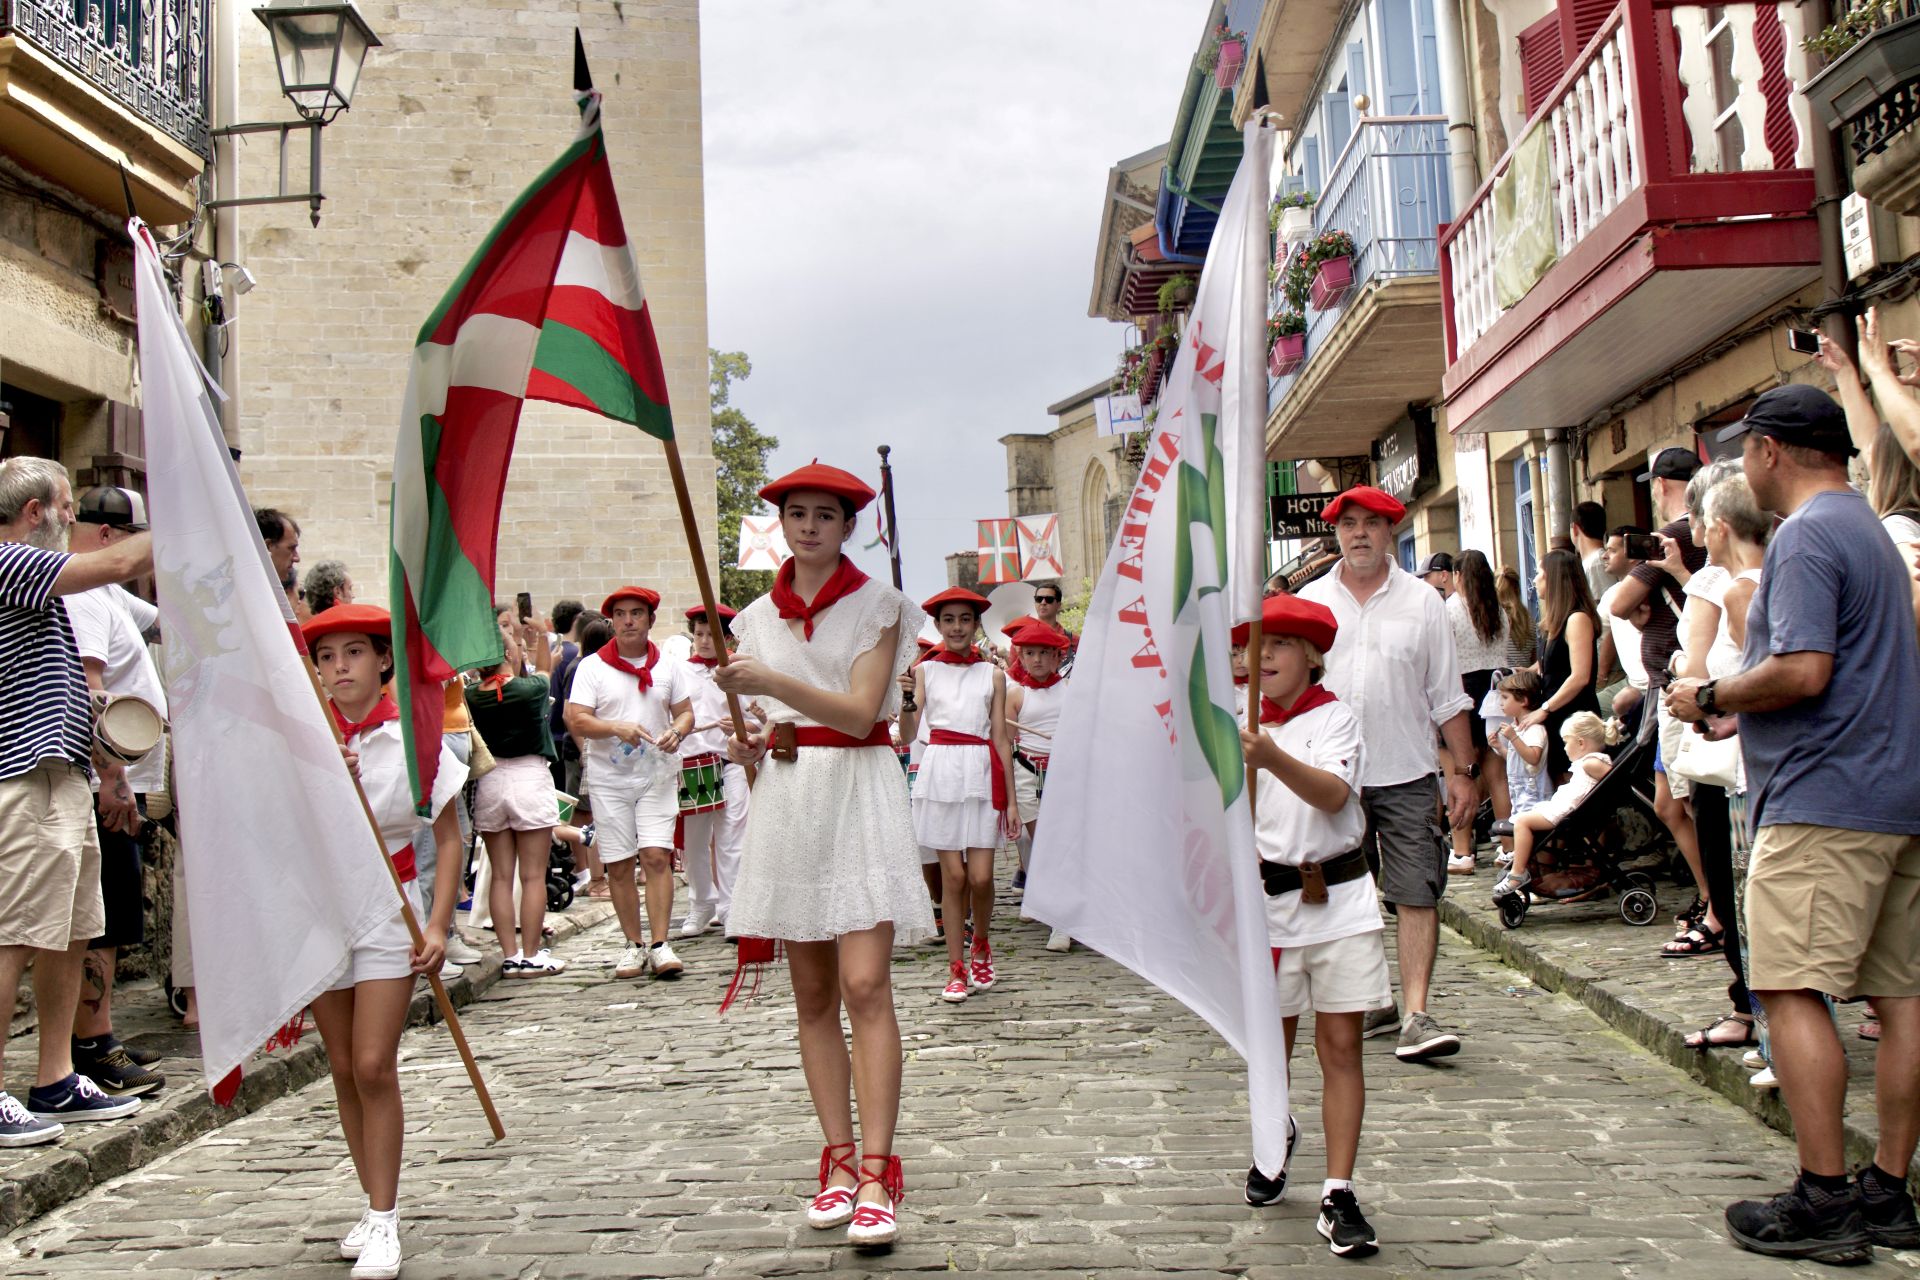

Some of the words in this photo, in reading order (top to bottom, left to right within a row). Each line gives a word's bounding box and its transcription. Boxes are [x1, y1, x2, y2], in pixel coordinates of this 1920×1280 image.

[1287, 497, 1332, 514] HOTE
[1278, 520, 1300, 536] San
[1306, 518, 1336, 533] Niko
